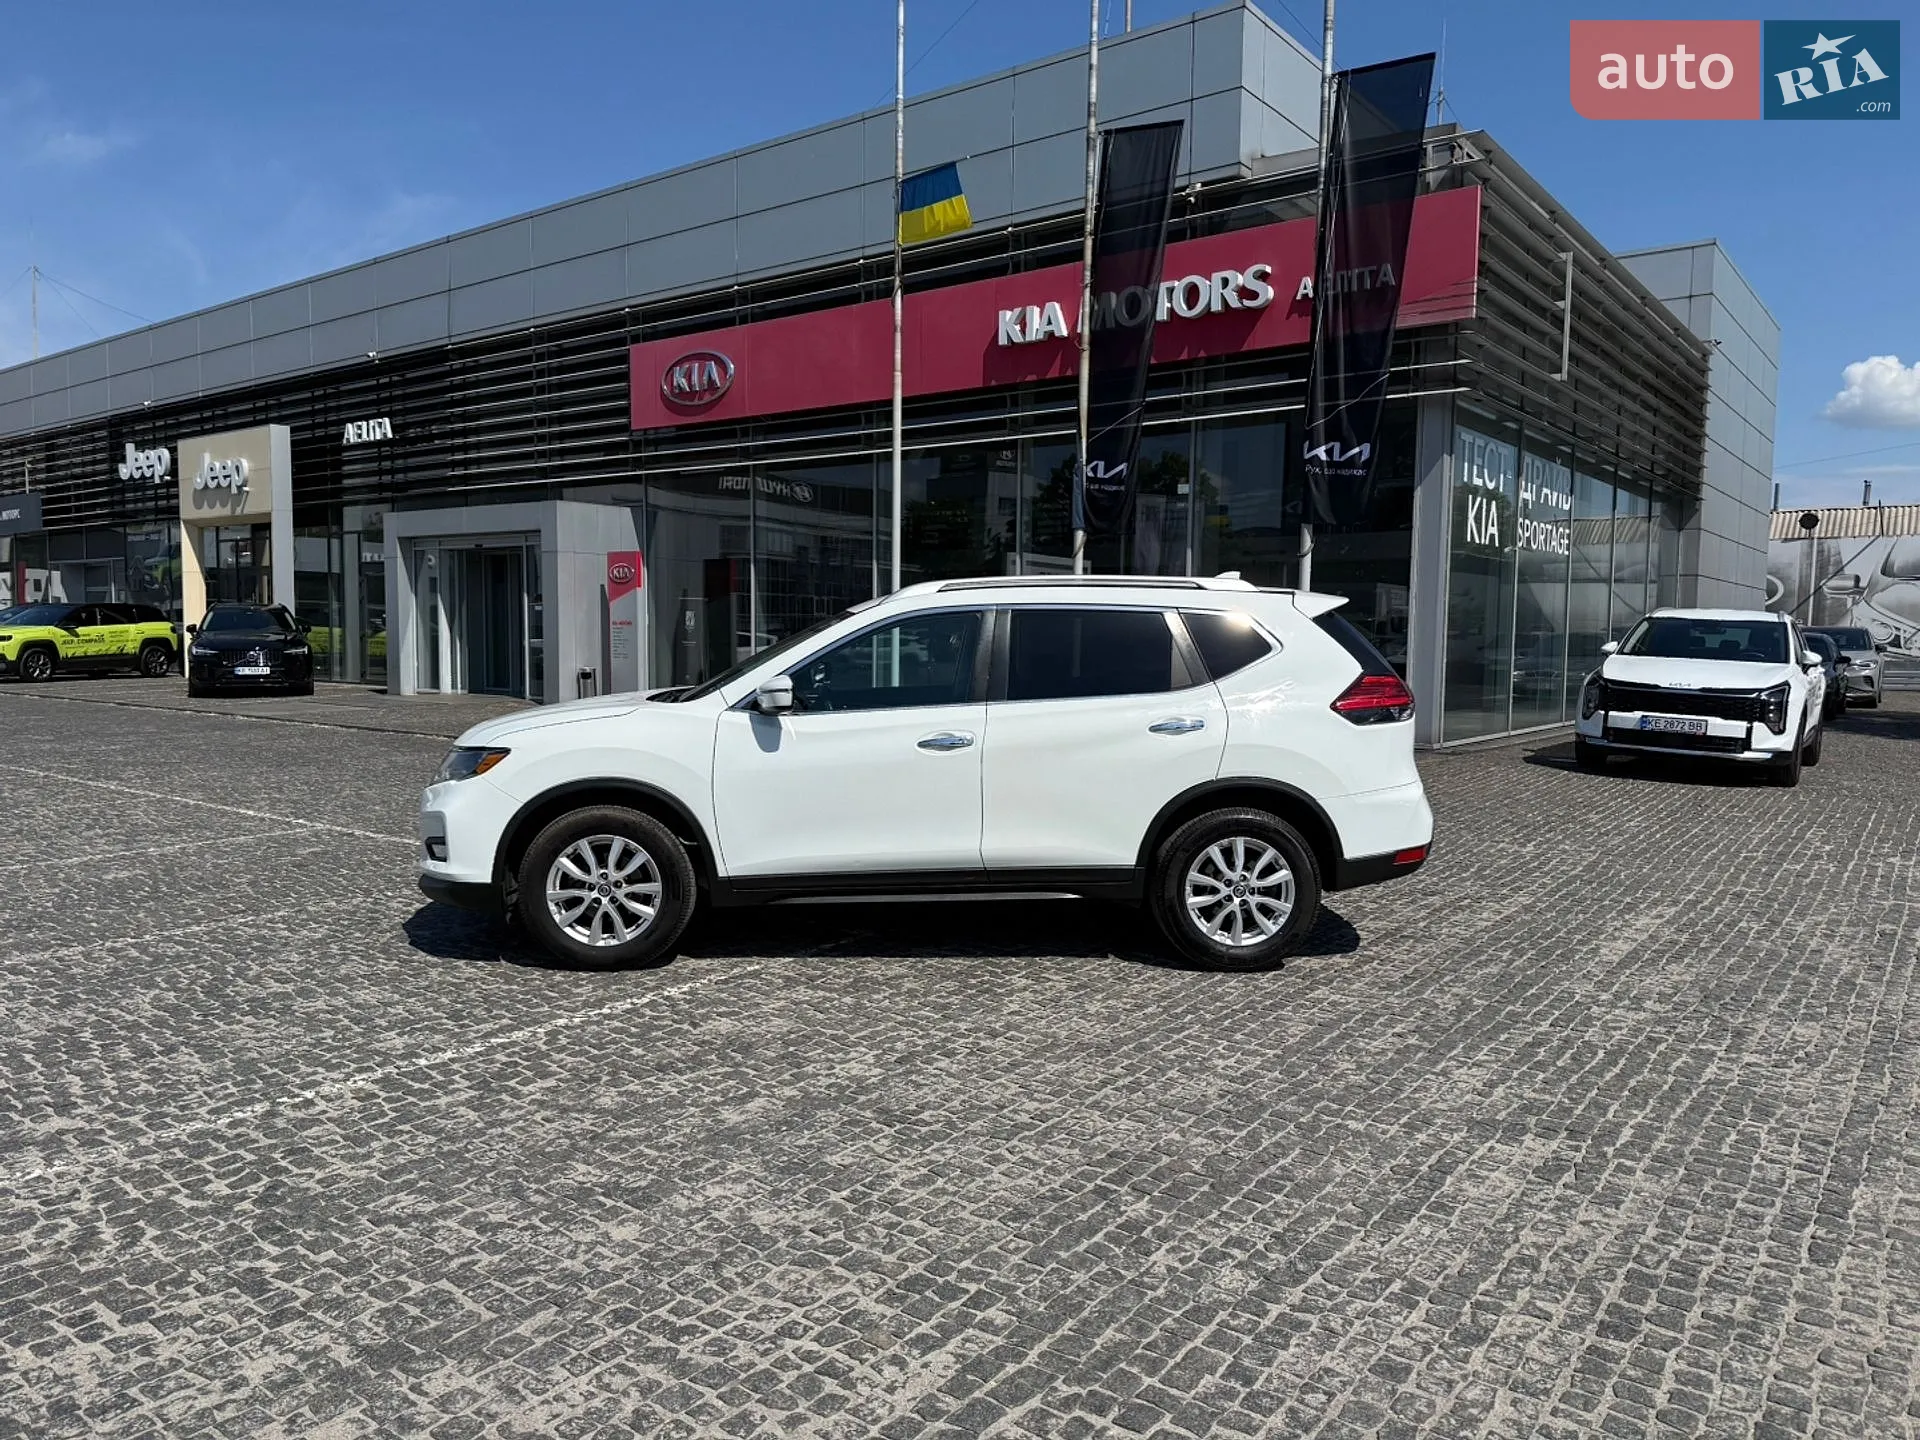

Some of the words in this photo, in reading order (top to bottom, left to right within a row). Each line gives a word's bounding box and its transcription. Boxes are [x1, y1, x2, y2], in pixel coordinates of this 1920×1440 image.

[998, 301, 1069, 346] KIA
[673, 360, 721, 393] KIA
[118, 442, 171, 483] Jeep
[194, 452, 249, 494] Jeep
[1466, 494, 1499, 548] KIA
[1517, 517, 1571, 556] SPORTAGE
[613, 567, 631, 580] KIA
